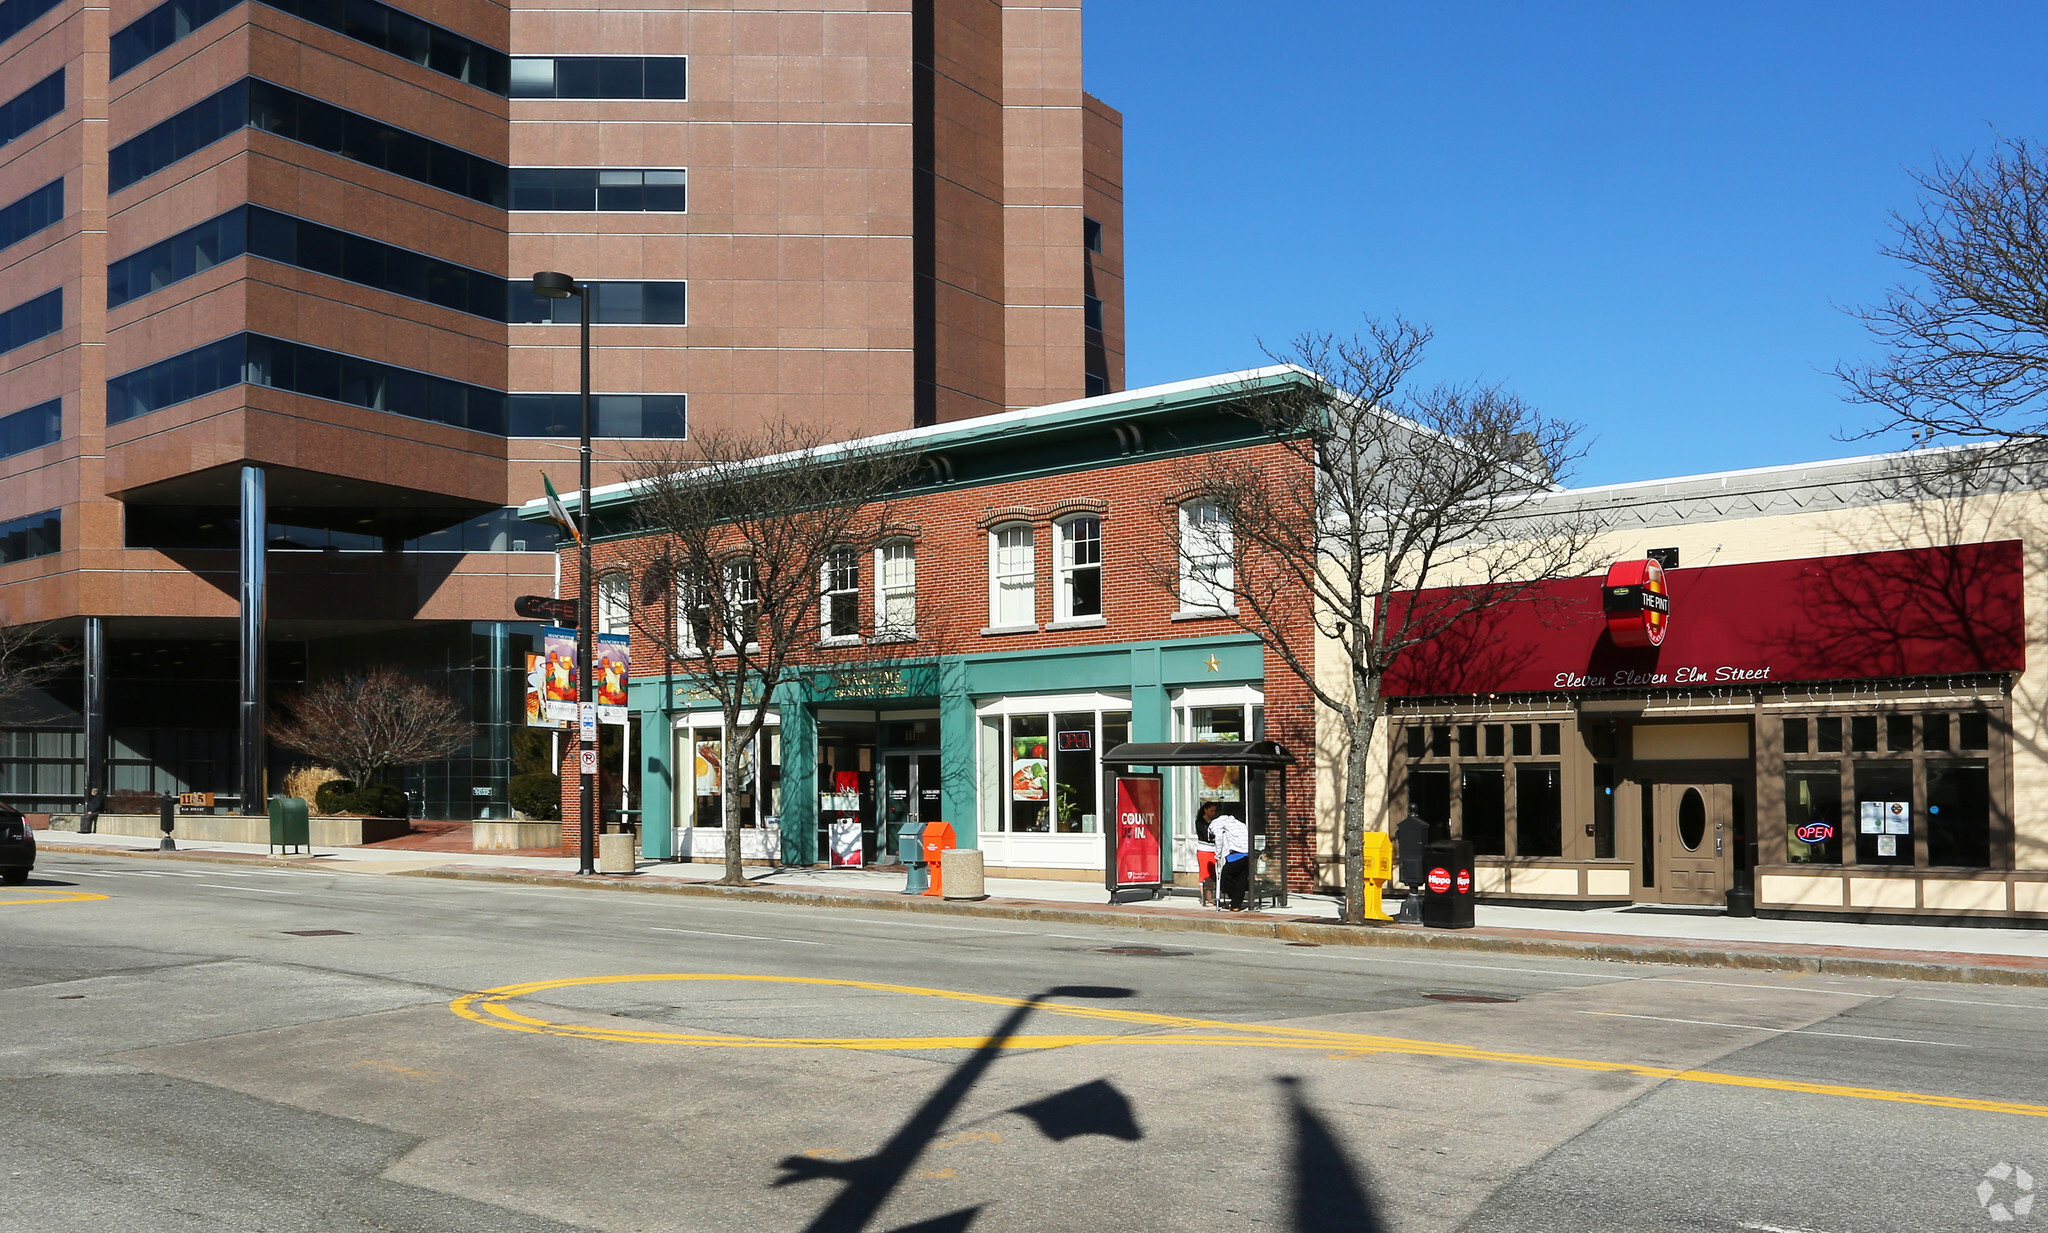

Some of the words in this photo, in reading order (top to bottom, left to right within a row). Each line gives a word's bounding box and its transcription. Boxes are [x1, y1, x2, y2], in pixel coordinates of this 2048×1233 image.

[1641, 592, 1655, 608] THE
[1655, 596, 1668, 611] PINT
[1553, 671, 1607, 689] Eleven
[1613, 669, 1668, 687] Eleven
[1674, 665, 1708, 684] Elm
[1714, 665, 1771, 682] Street
[834, 686, 875, 698] PROGRAM
[878, 684, 907, 695] GROUP
[1060, 732, 1090, 749] OPEN
[1121, 812, 1155, 825] COUNT
[1121, 827, 1132, 839] US
[1134, 826, 1146, 839] IN.
[1797, 826, 1834, 839] OPEN
[1428, 874, 1452, 885] Hippo
[1457, 876, 1470, 886] Hippo
